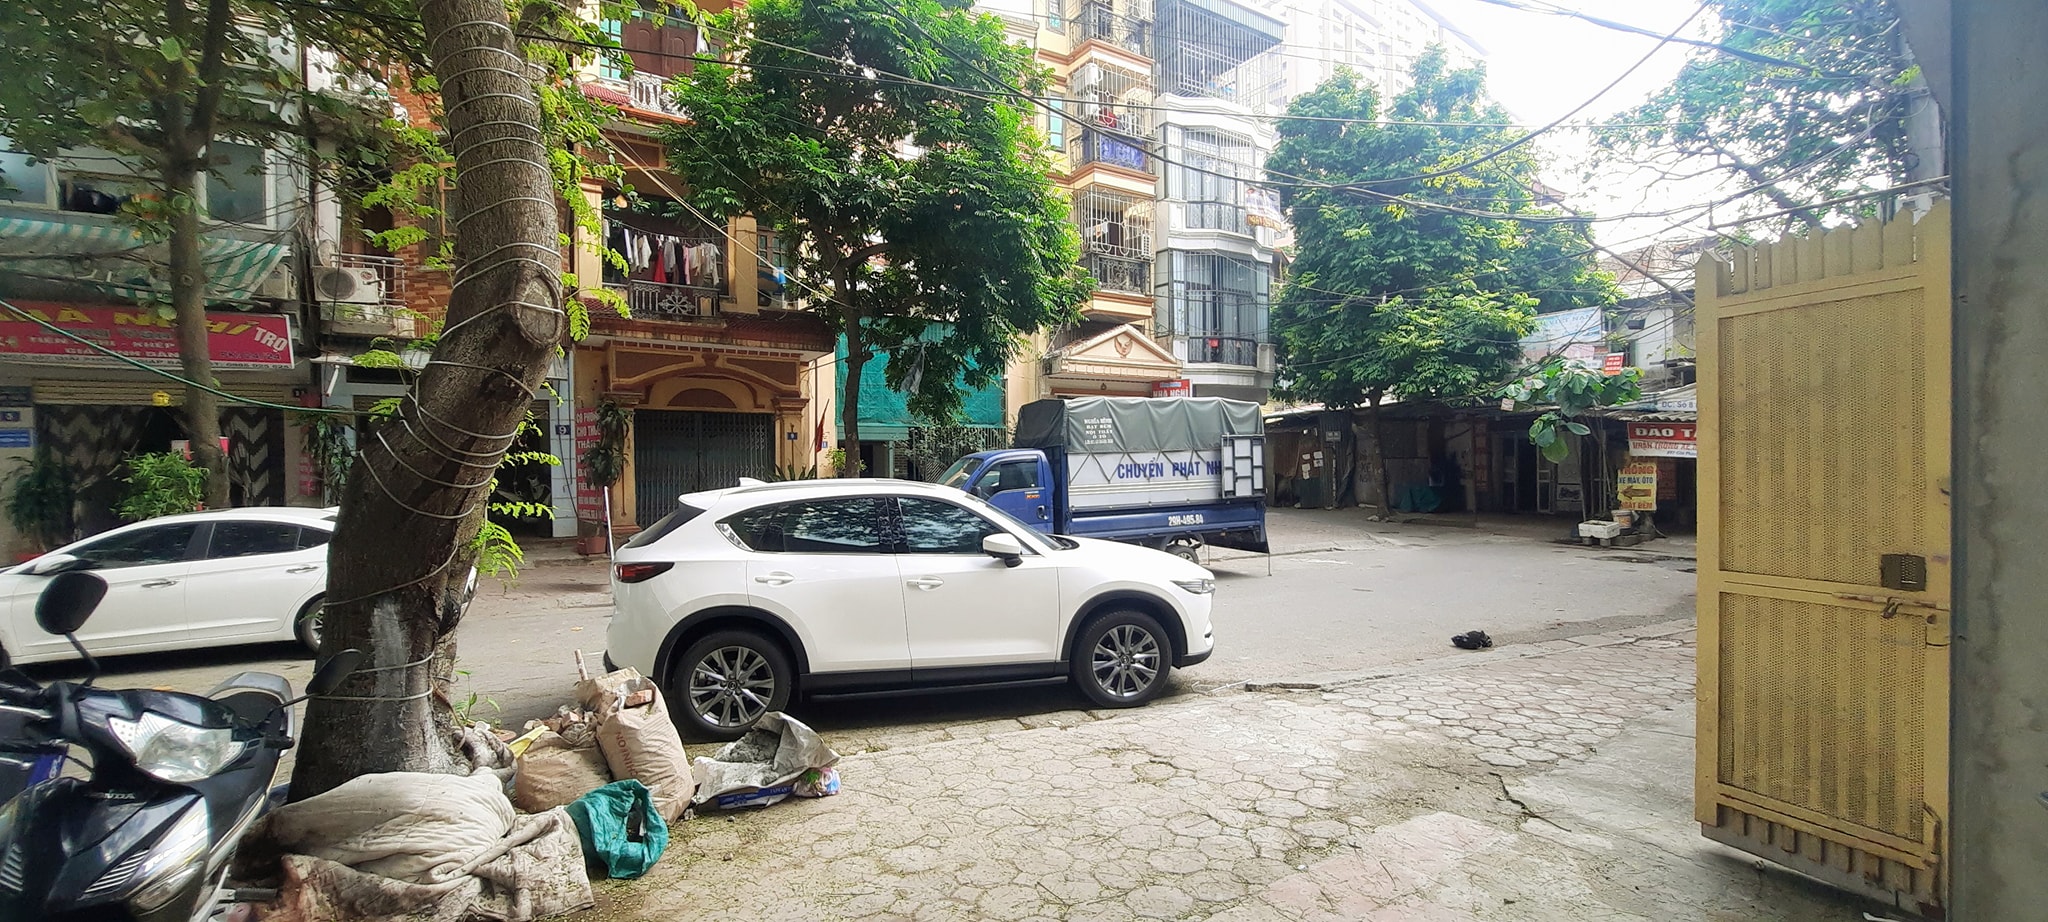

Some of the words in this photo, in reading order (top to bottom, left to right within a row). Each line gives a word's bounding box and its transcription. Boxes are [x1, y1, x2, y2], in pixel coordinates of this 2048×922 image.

[254, 326, 288, 353] TRỌ
[559, 426, 568, 434] 9
[1117, 456, 1164, 479] CHUYỂN
[1206, 460, 1222, 476] NH
